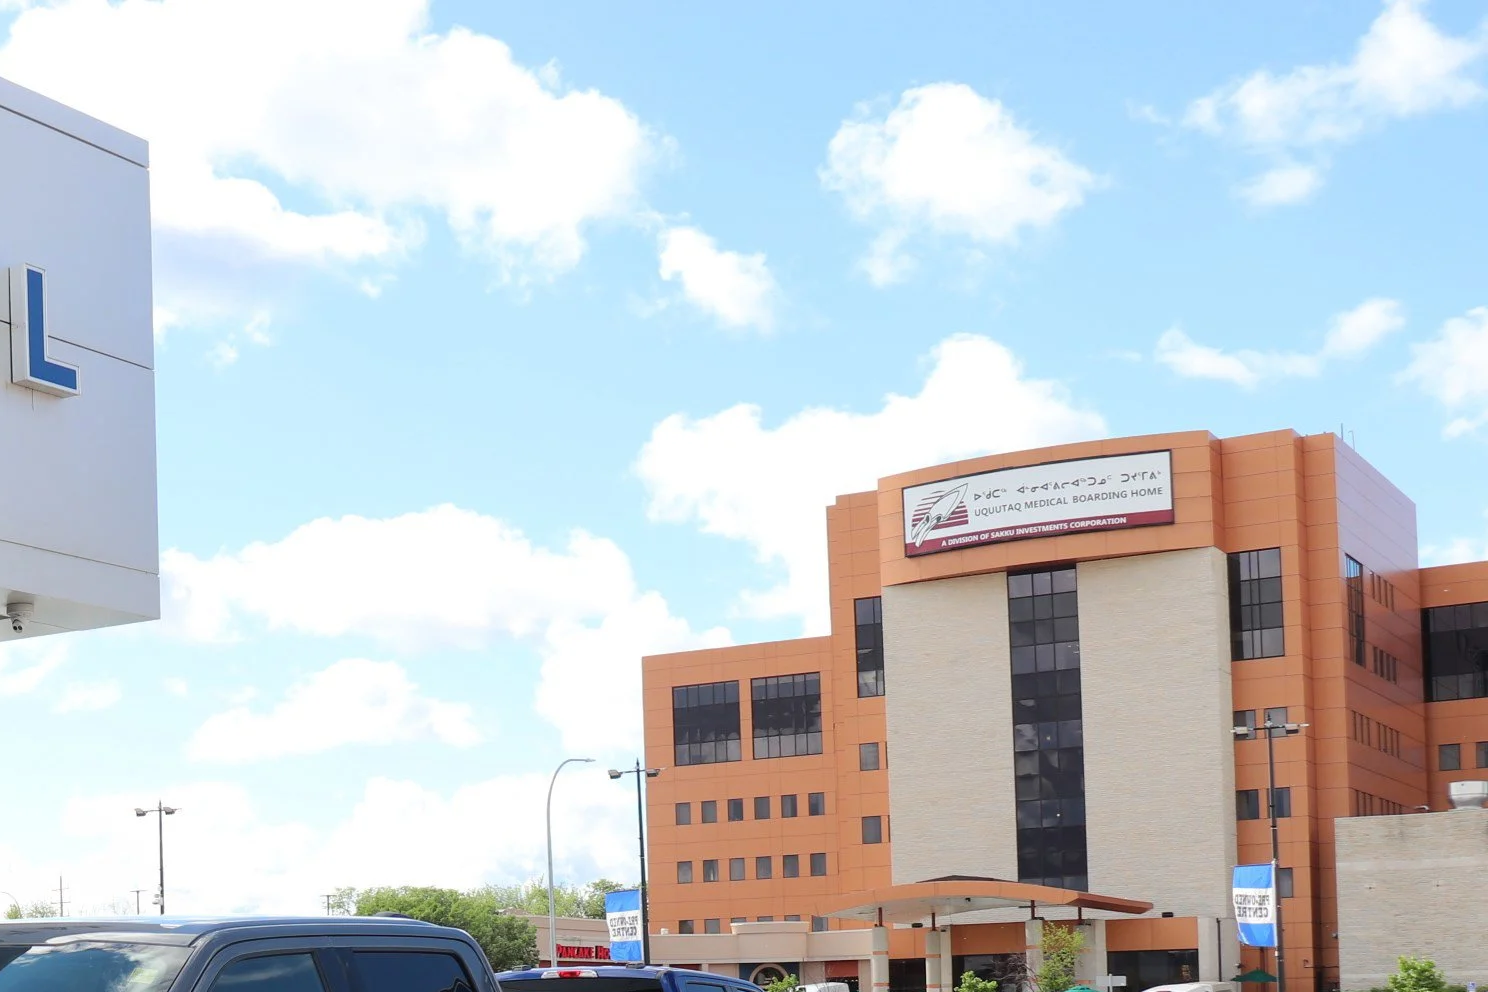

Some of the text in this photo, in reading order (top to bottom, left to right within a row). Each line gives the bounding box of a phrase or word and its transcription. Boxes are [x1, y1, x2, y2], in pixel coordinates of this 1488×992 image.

[974, 487, 1163, 517] UQUUTAQ MEDICAL BOARDING HOME
[948, 534, 979, 545] DIVISION
[979, 531, 990, 540] OF
[990, 529, 1015, 539] SAKKU
[1016, 522, 1069, 535] INVESTMENTS
[1069, 516, 1127, 529] CORPORATION
